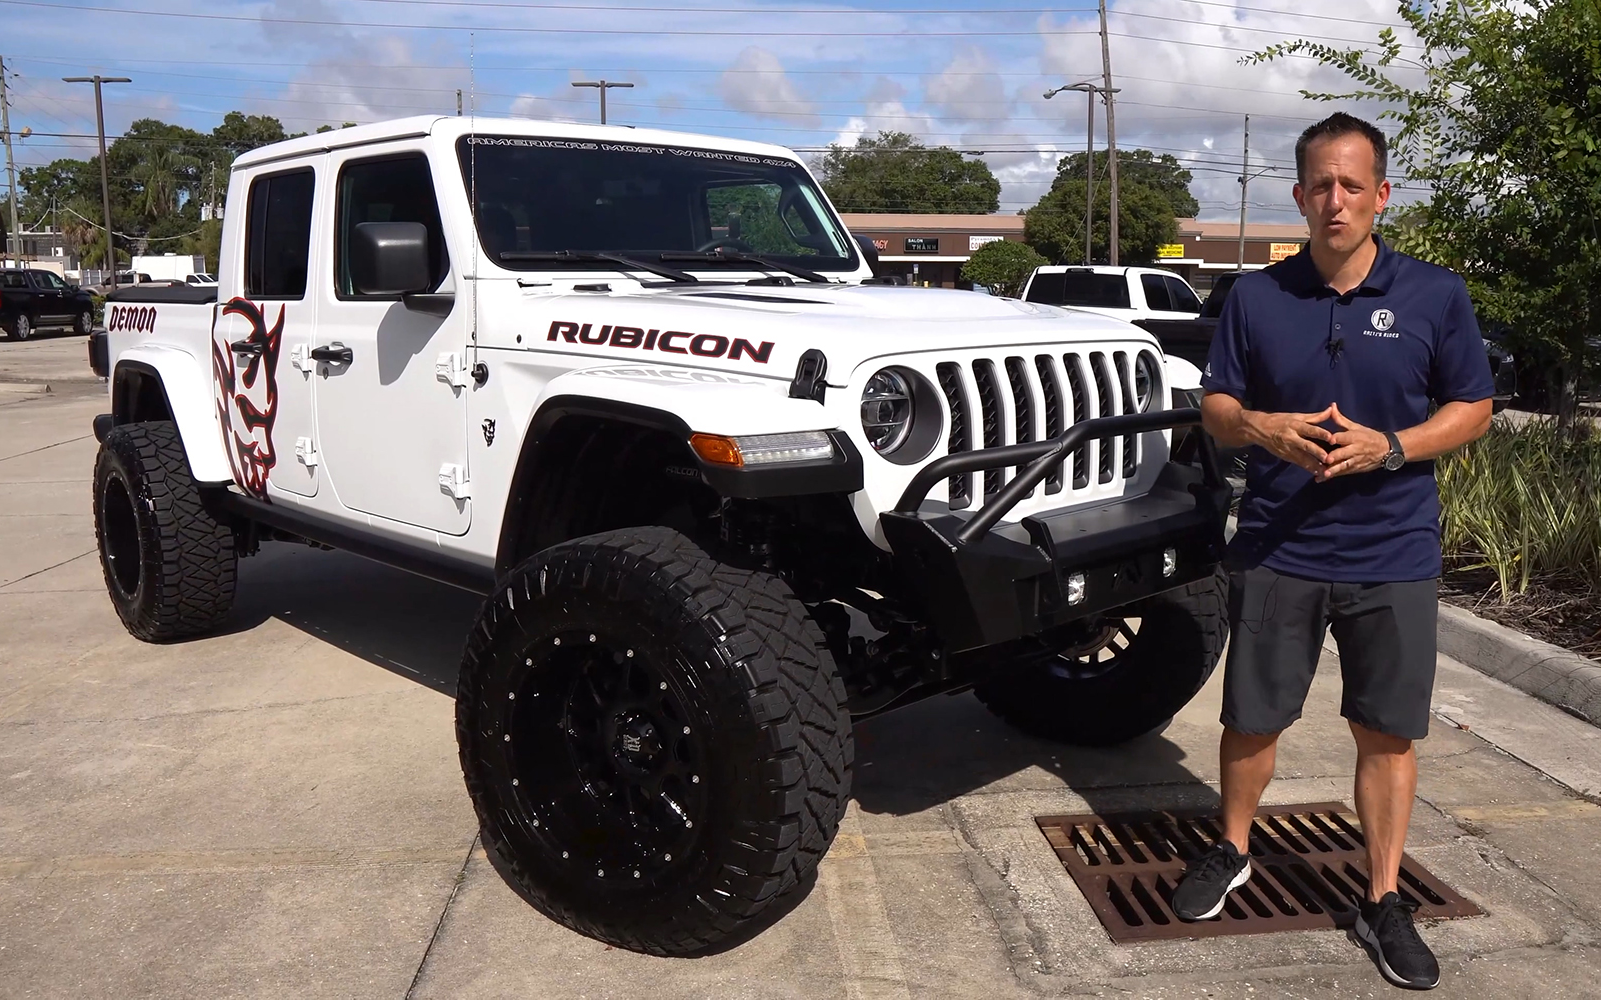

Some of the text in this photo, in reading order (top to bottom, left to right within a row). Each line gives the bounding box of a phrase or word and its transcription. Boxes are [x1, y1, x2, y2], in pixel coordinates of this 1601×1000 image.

[467, 137, 598, 150] AMERICAS
[601, 143, 666, 155] MOST
[669, 149, 760, 164] WANTED
[109, 305, 157, 334] DEMON
[1377, 312, 1387, 326] R
[546, 320, 776, 364] RUBICON
[665, 465, 699, 477] FALCON
